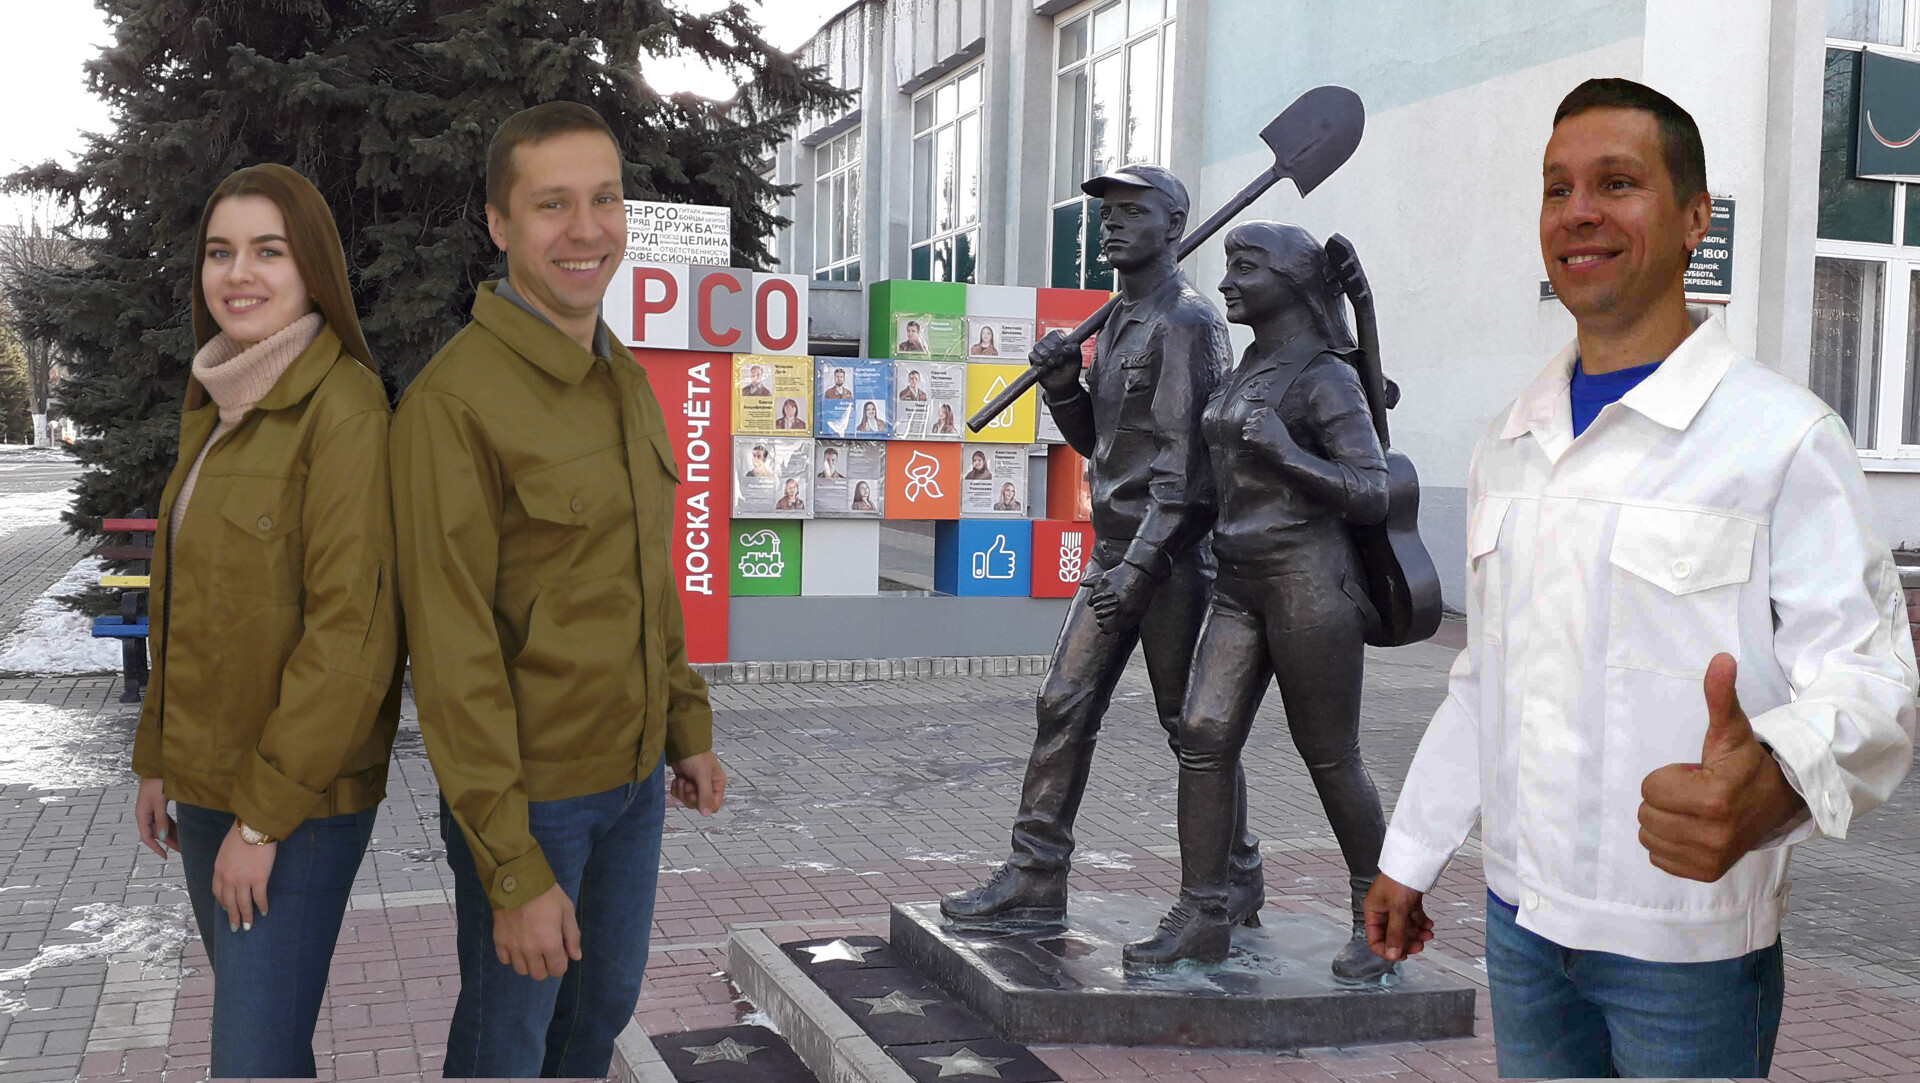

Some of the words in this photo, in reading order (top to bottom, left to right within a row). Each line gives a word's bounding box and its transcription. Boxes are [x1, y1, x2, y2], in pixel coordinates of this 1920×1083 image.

[627, 217, 651, 227] ТРЯД
[679, 214, 704, 222] БОЙЦЫ
[654, 220, 713, 234] ДРУЖБА
[627, 231, 658, 246] РУД
[680, 235, 728, 247] ЦЕЛИНА
[1702, 236, 1728, 244] АБОТЫ:
[659, 246, 728, 257] ОТВЕТСТВЕННОСТЬ
[623, 251, 729, 266] РОФЕССИОНАЛИЗМ
[1689, 262, 1720, 270] ХОДНОЙ:
[1684, 278, 1723, 287] СКРЕСЕНЬЕ
[632, 266, 798, 350] РСО
[683, 361, 712, 482] ПОЧЁТА
[685, 490, 713, 596] ДОСКА
